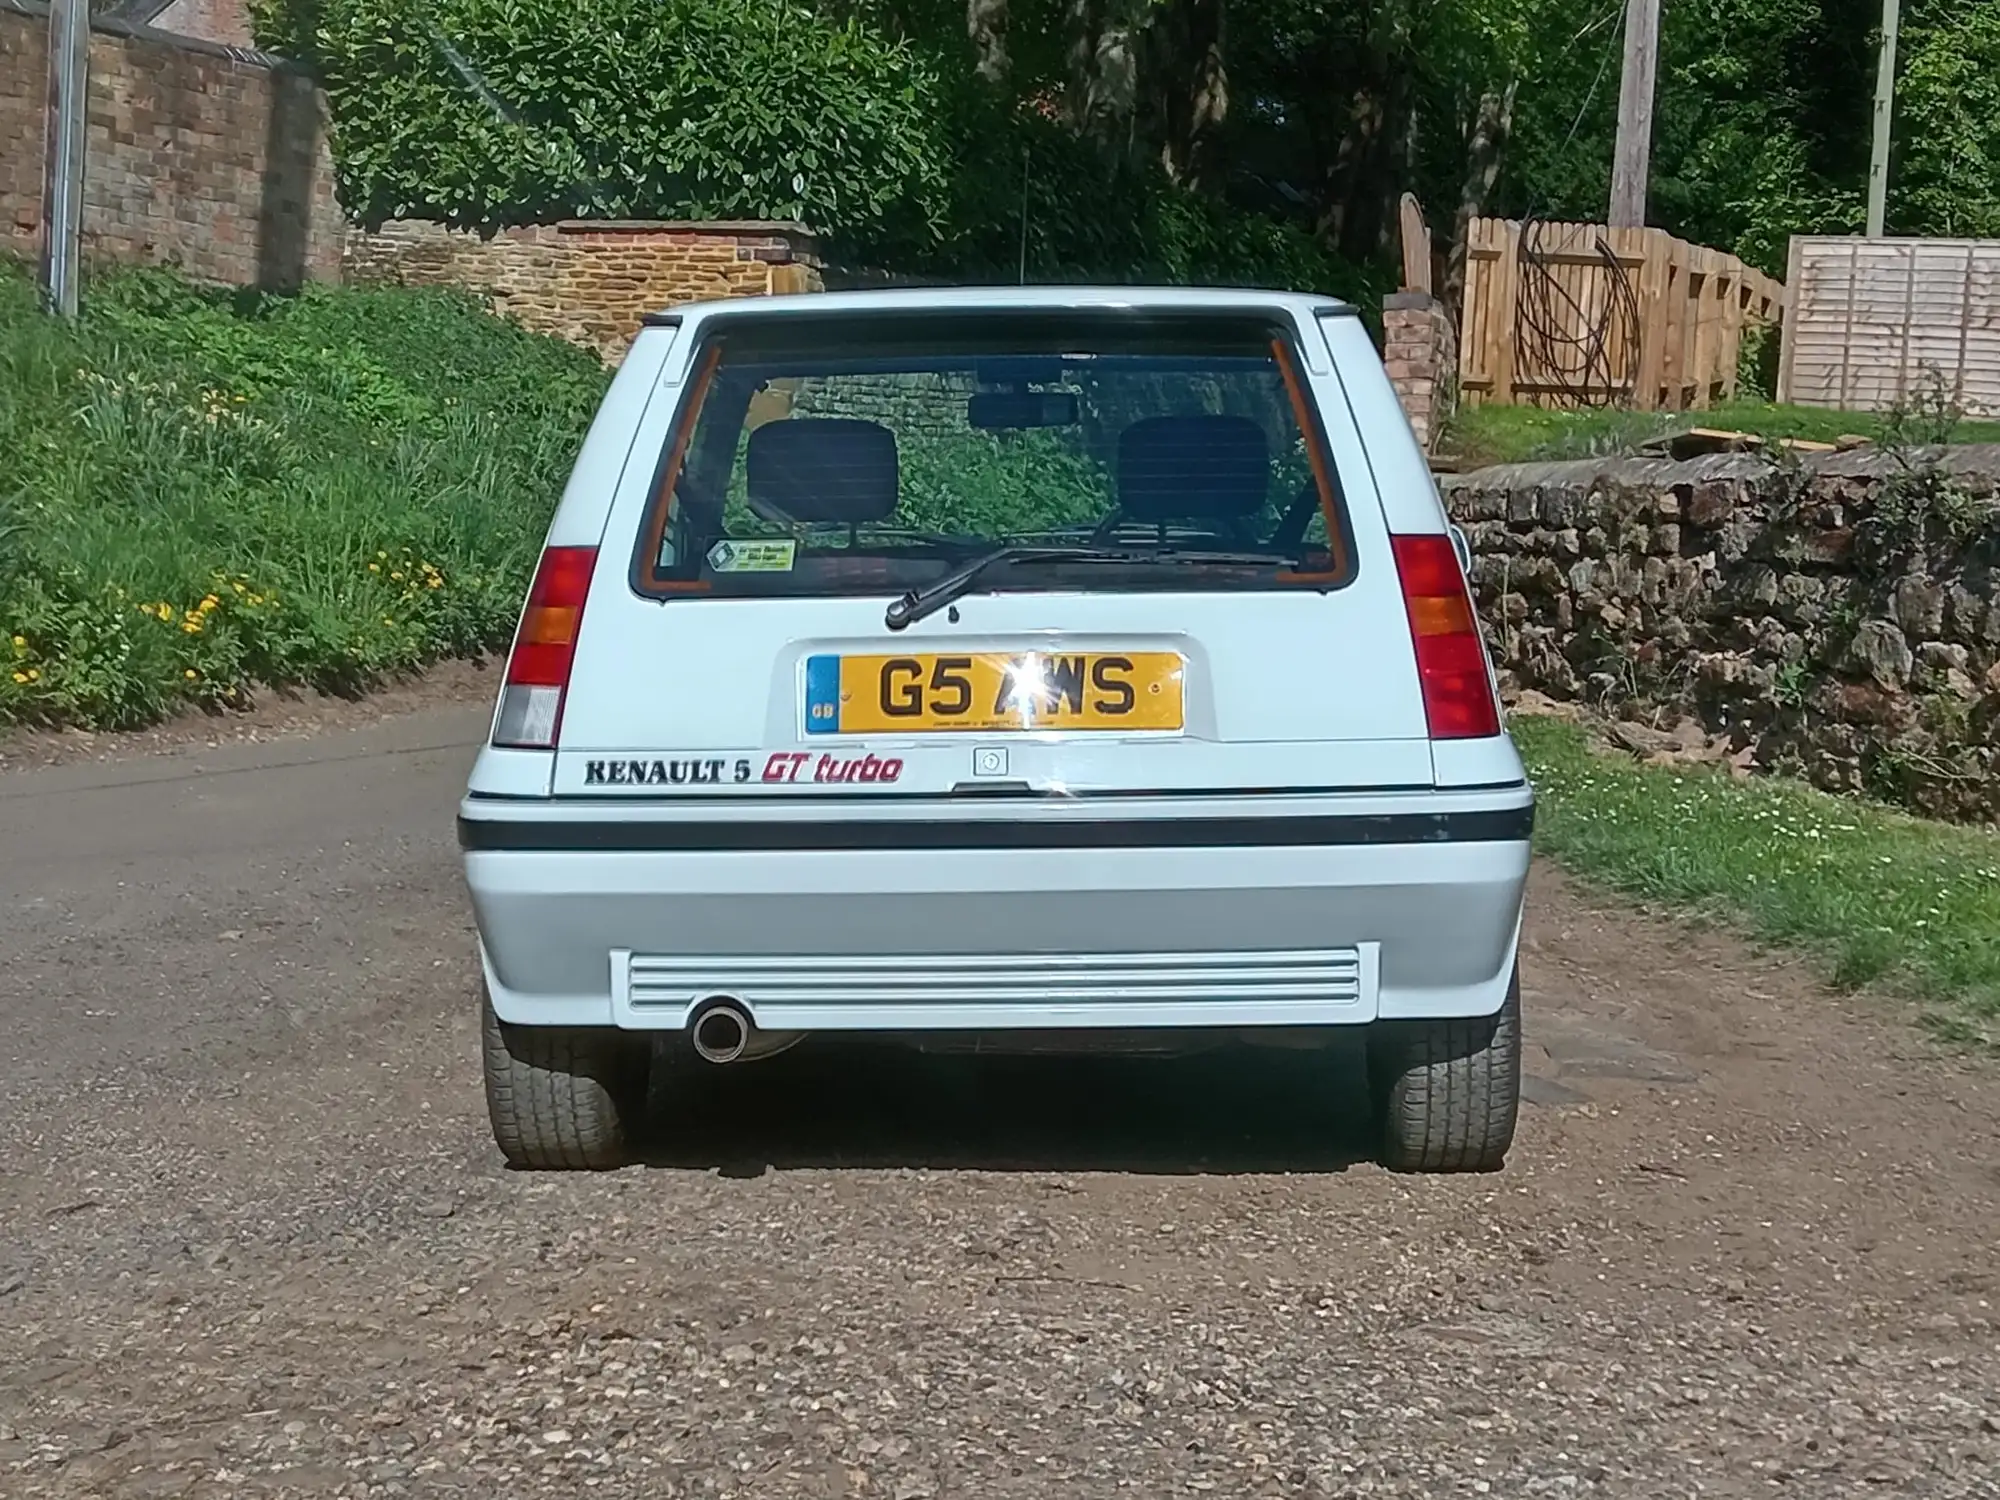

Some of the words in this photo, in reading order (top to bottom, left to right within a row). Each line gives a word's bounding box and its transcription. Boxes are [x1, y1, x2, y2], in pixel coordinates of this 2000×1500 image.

[880, 657, 973, 716] G5
[585, 759, 724, 784] RENAULT
[733, 759, 751, 783] 5
[761, 752, 812, 783] GT
[813, 753, 904, 782] turbo
